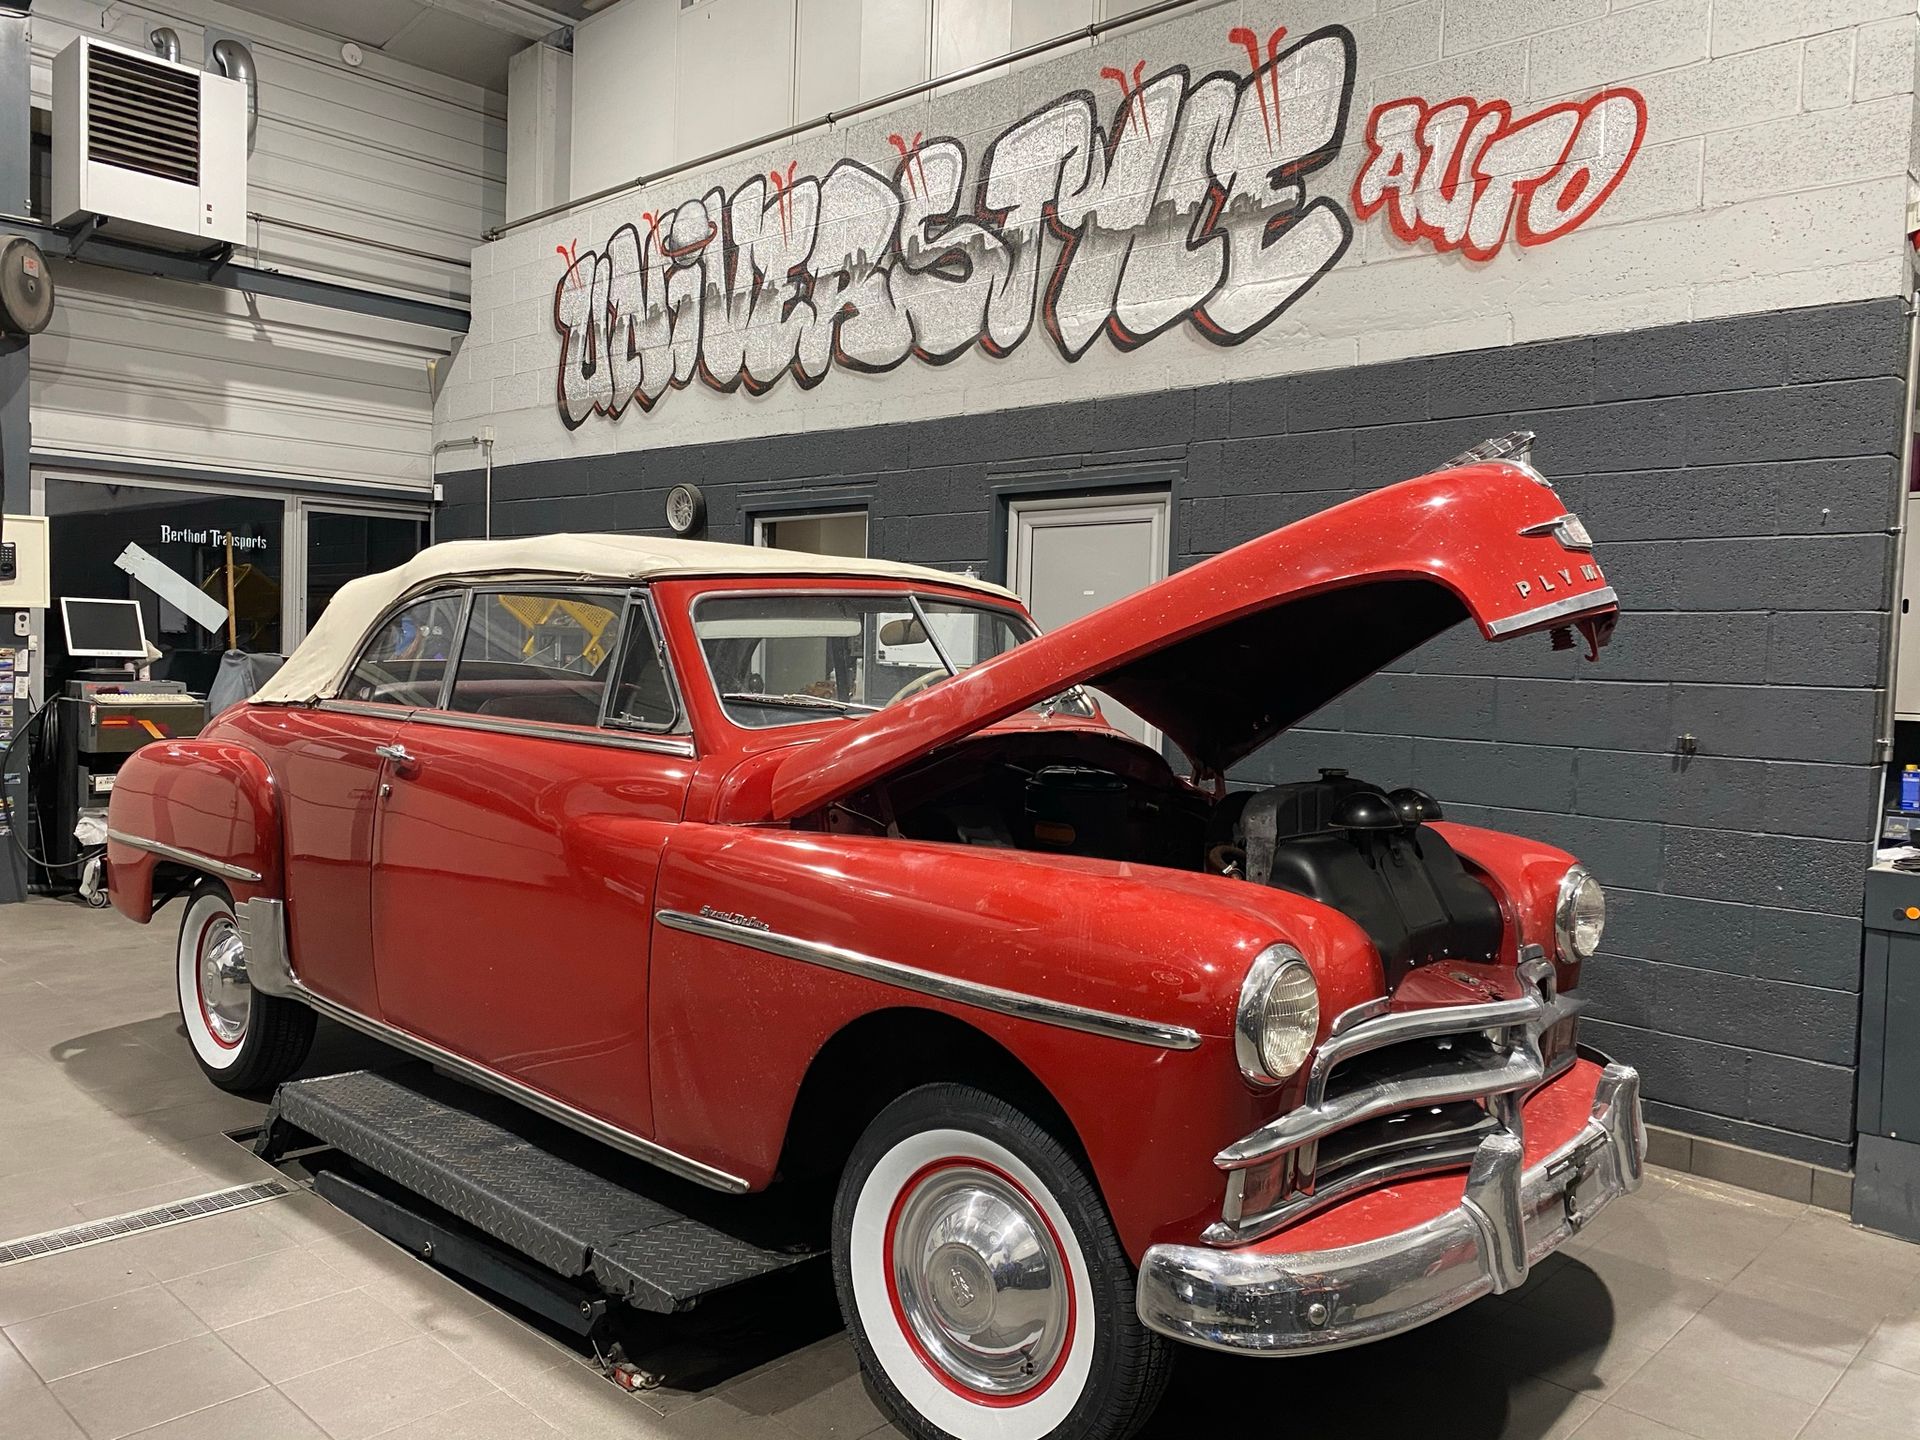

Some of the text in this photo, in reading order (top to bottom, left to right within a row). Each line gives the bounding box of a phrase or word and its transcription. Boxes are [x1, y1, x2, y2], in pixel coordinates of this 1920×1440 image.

[1351, 87, 1647, 262] AUTO
[160, 524, 207, 544] Berthod
[1516, 564, 1604, 598] PLYM
